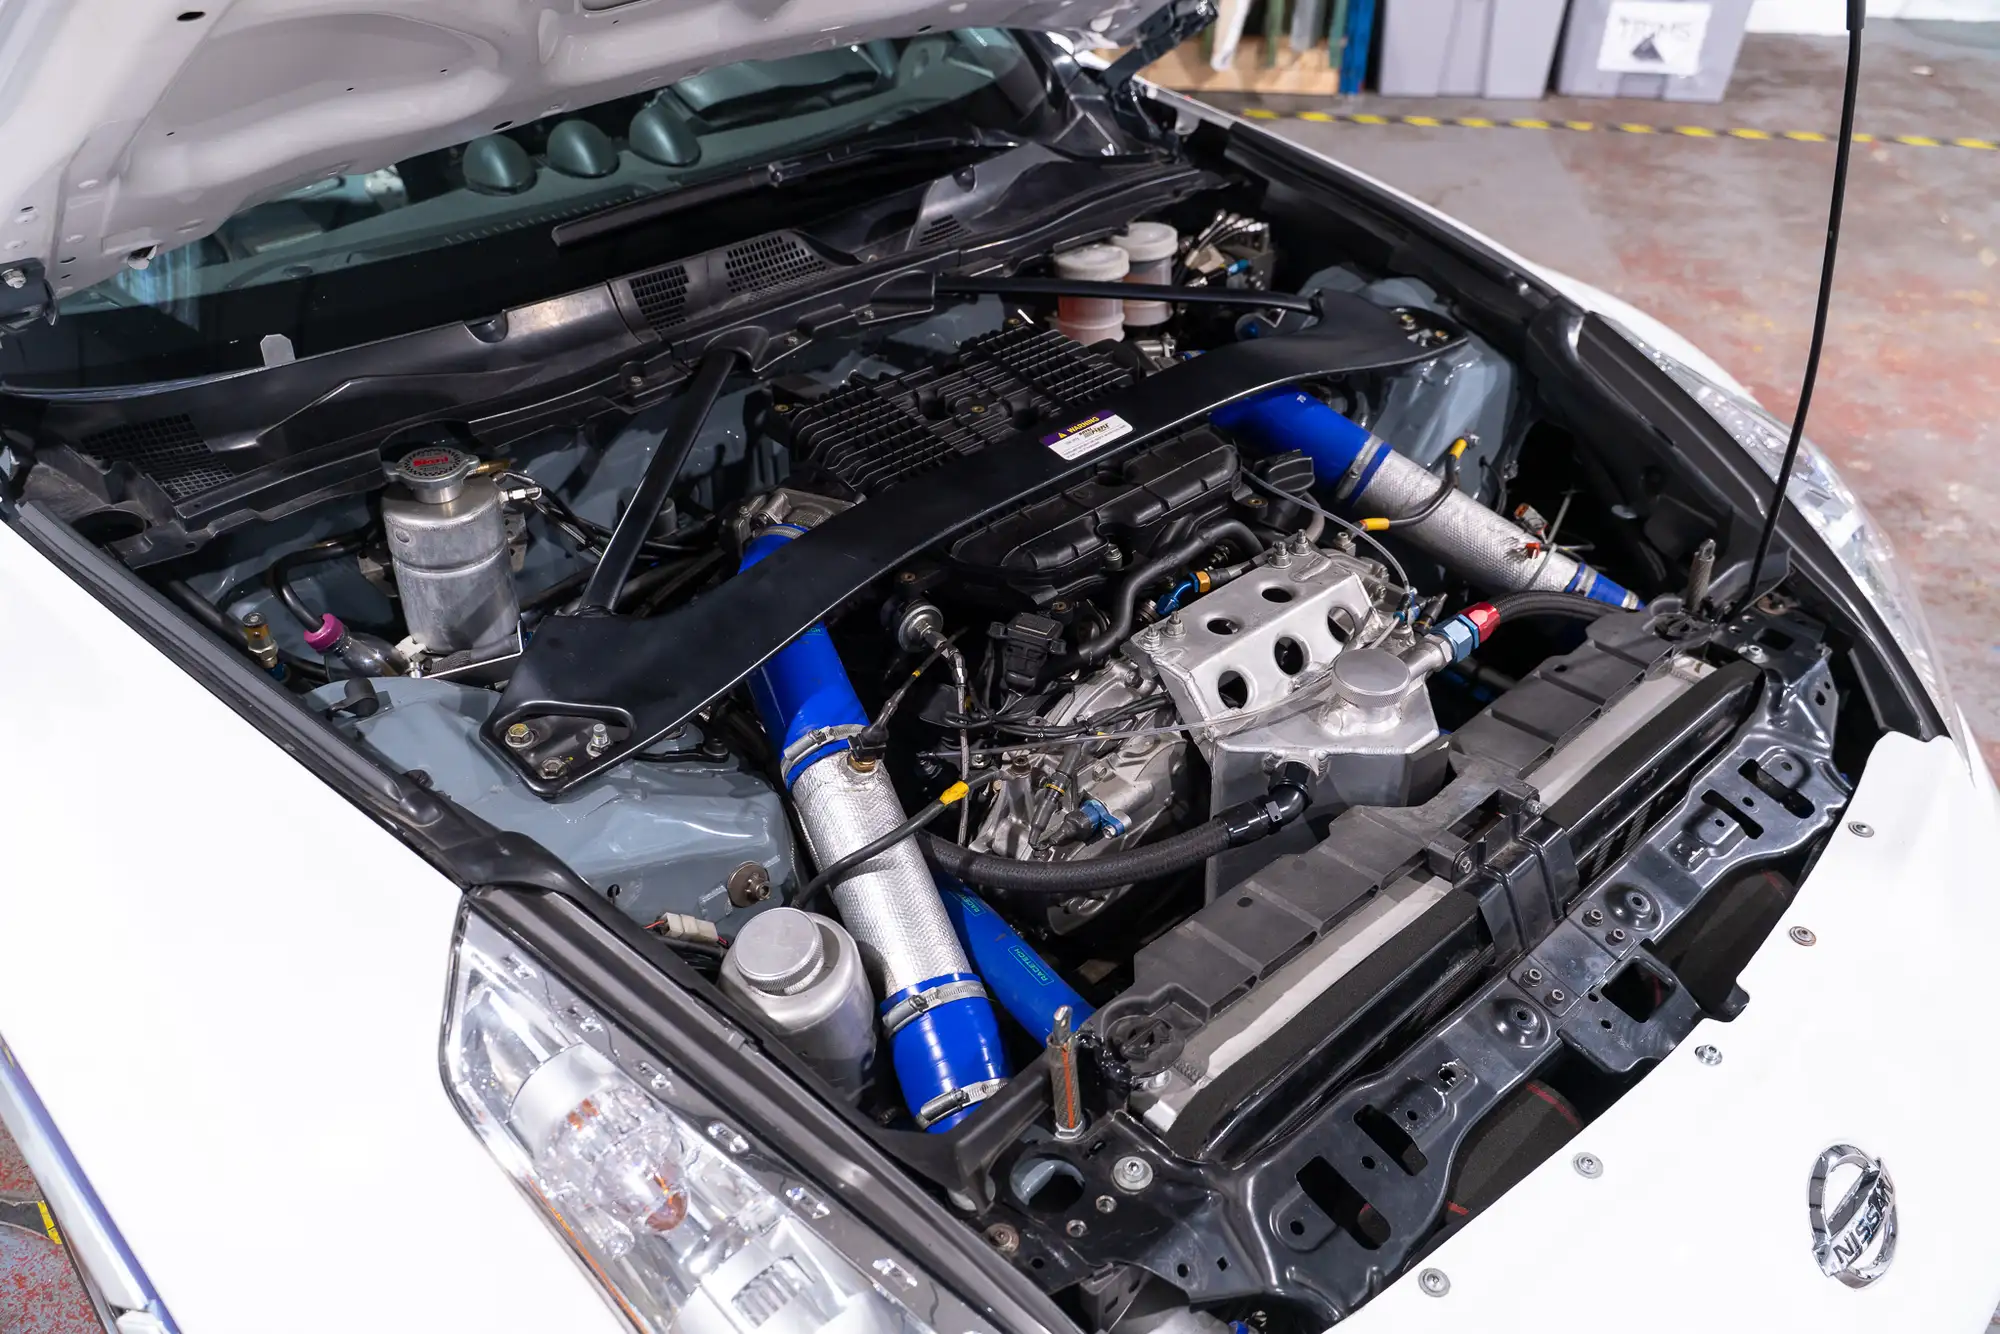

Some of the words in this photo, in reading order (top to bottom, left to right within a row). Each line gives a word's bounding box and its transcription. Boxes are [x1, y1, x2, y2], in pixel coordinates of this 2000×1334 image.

[1067, 416, 1100, 433] WARNING
[1013, 948, 1049, 982] RACETECH
[1832, 1175, 1894, 1265] NISSAN
